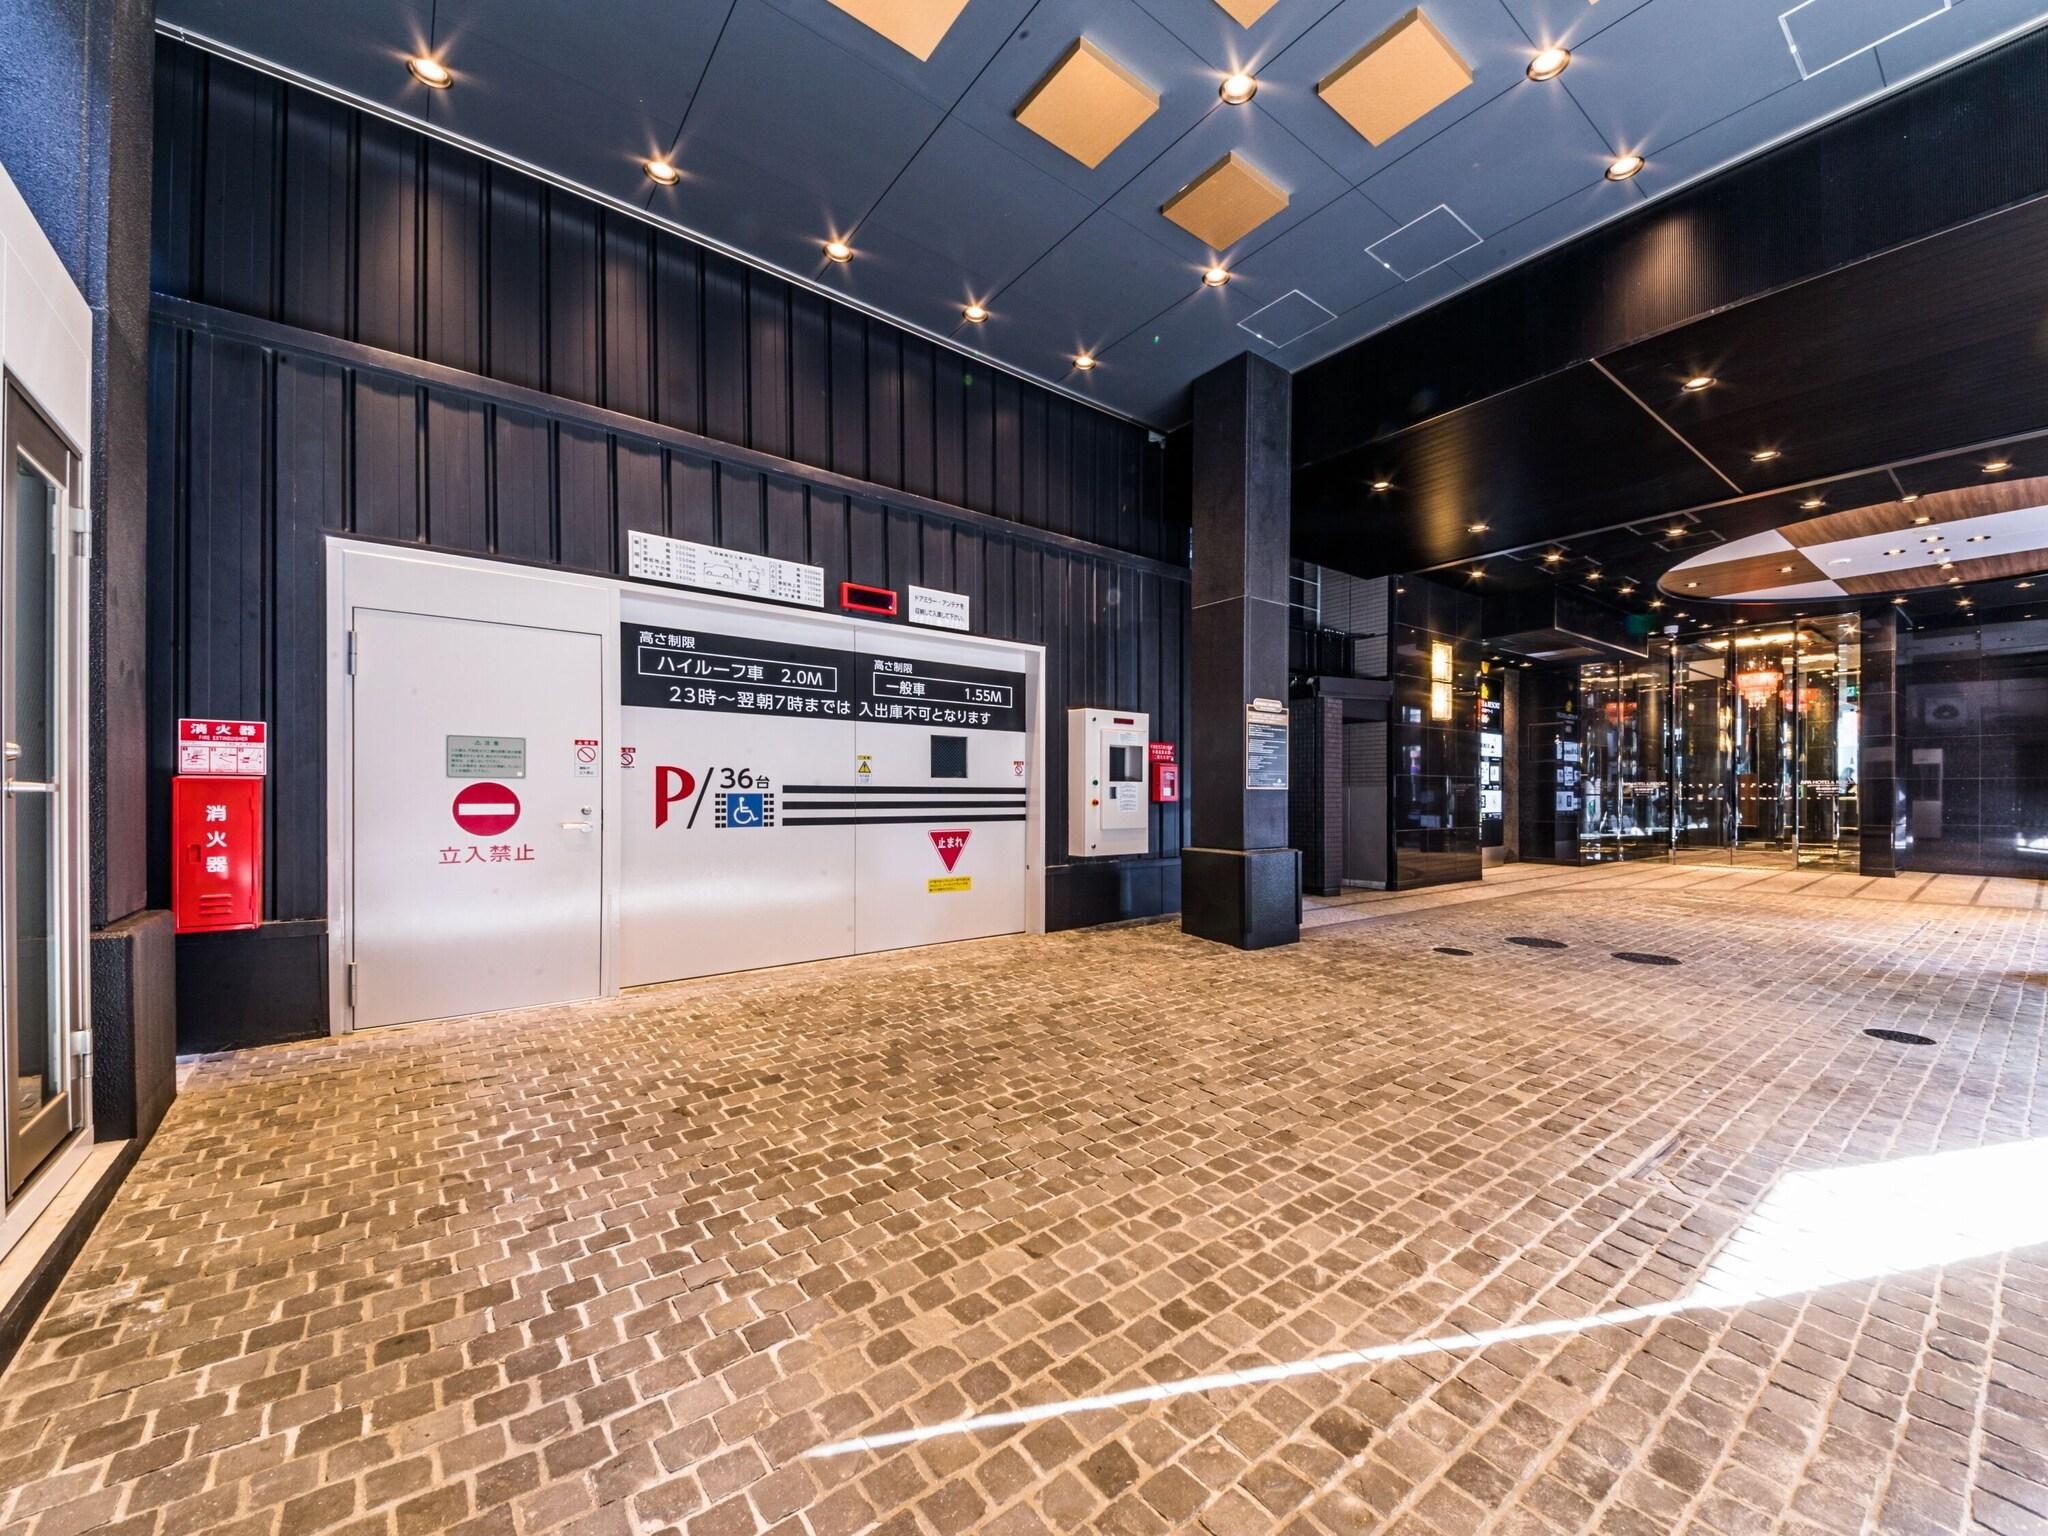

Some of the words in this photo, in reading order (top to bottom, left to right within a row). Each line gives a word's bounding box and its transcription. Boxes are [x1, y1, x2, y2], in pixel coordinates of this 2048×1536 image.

[639, 631, 696, 649] 高さ制限
[657, 656, 764, 681] ハイルーフ車
[781, 668, 823, 686] 2.0M
[873, 659, 913, 674] 高さ制限
[886, 680, 926, 696] 一般車
[965, 687, 1002, 703] 1.55M
[858, 701, 991, 725] 入出庫不可となります
[190, 723, 256, 736] 消火器
[206, 804, 228, 874] 消火器
[938, 836, 964, 848] 止まれ
[438, 844, 535, 864] 立入禁止
